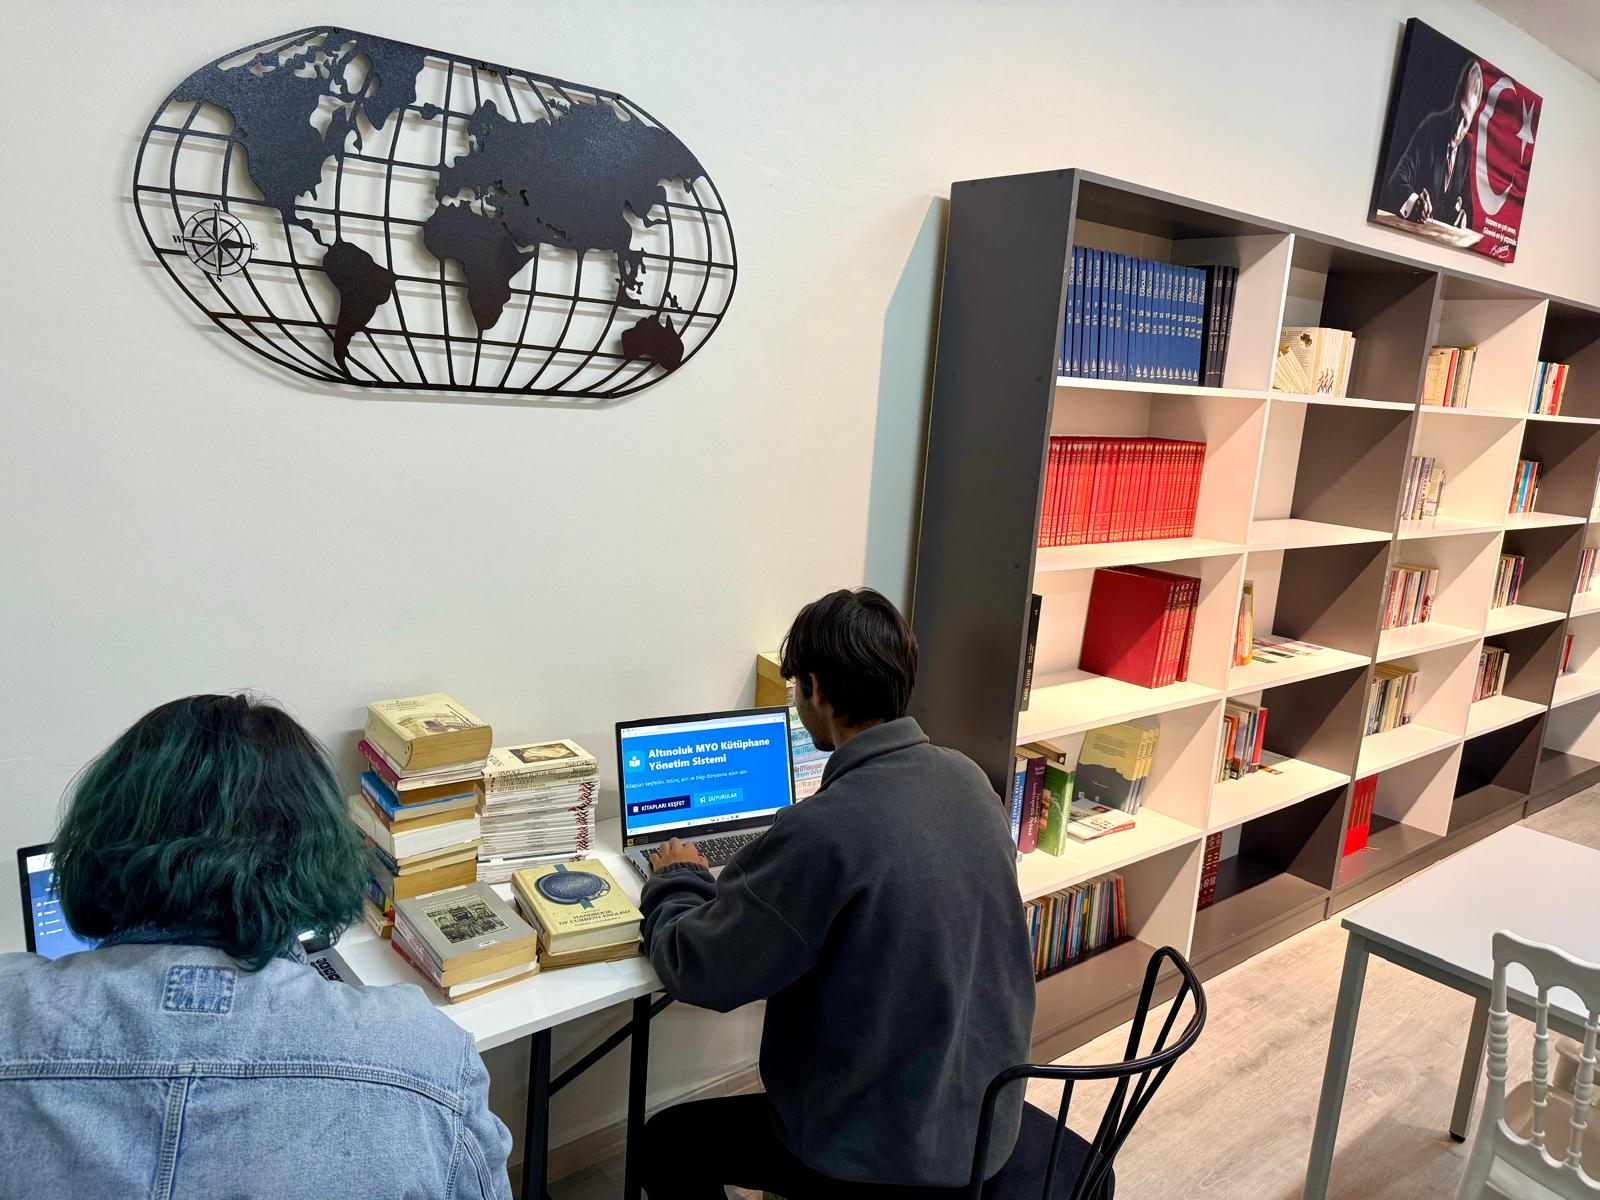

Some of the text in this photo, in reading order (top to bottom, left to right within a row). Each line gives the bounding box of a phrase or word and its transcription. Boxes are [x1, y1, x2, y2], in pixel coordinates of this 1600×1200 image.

[648, 738, 770, 759] Altınoluk MYO Kütüphane
[649, 754, 727, 771] Yönetim Sistemi
[641, 800, 686, 811] KİTAPLARI KEŞFET
